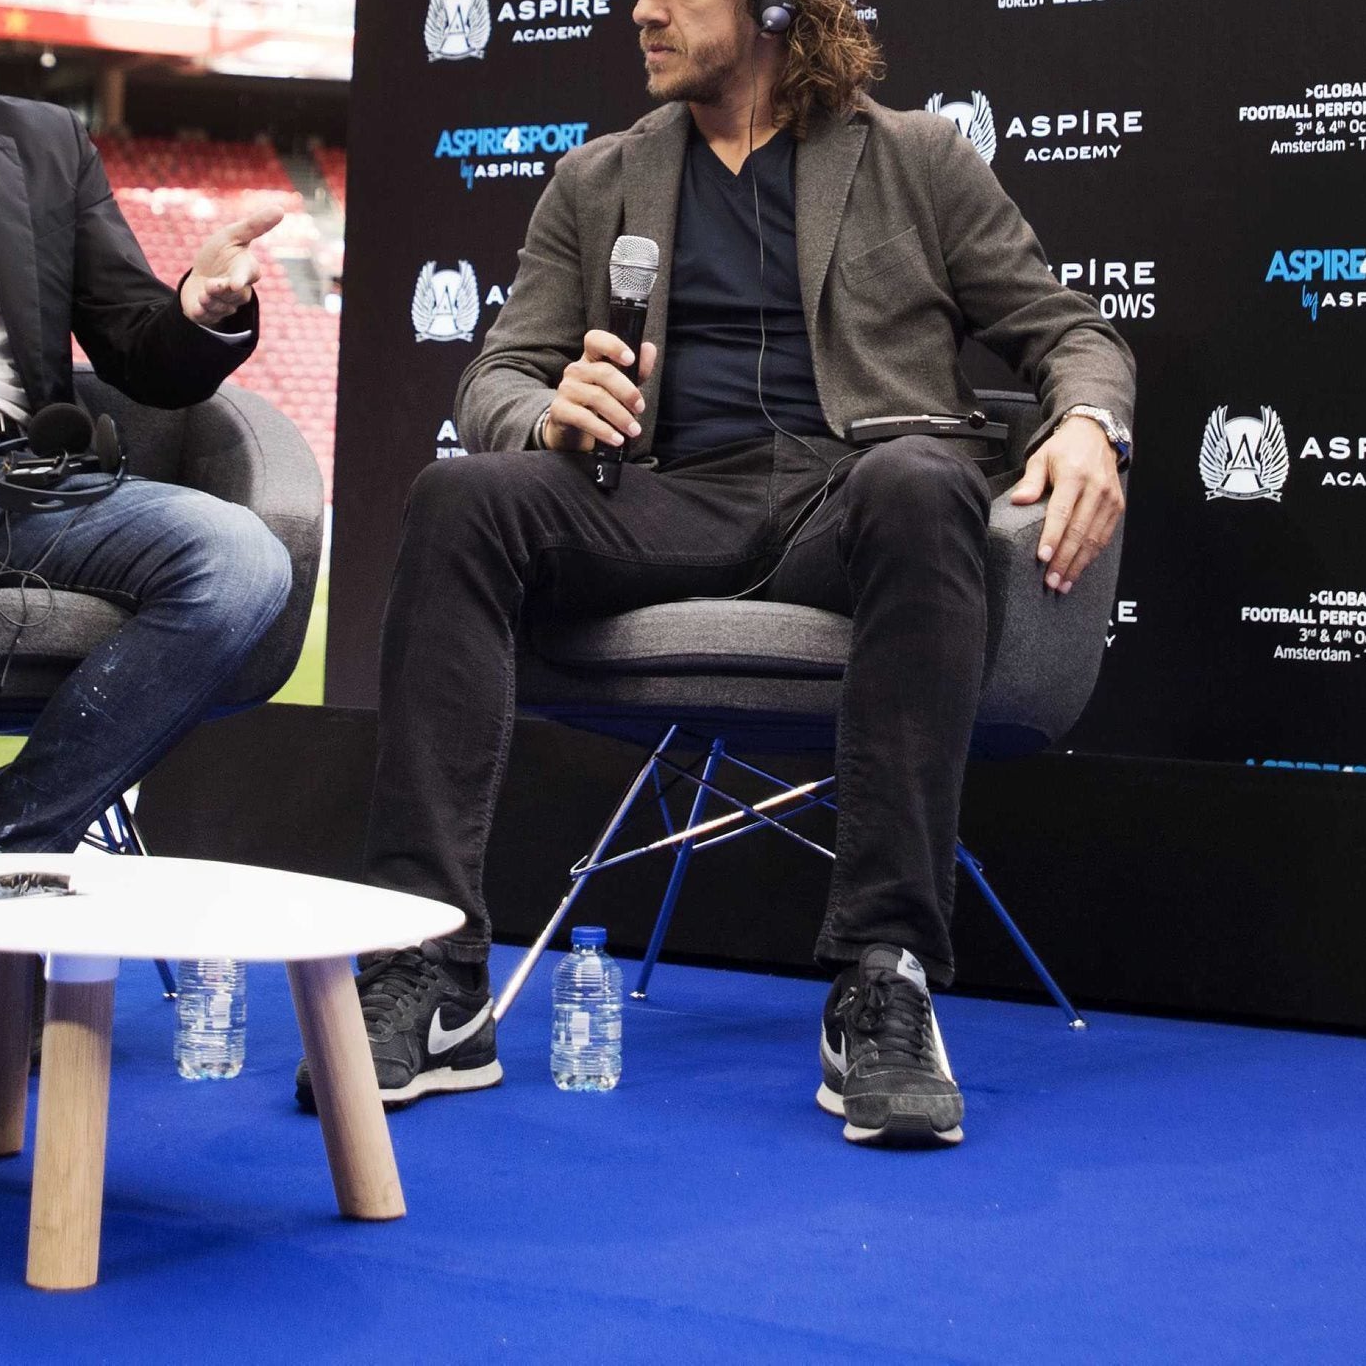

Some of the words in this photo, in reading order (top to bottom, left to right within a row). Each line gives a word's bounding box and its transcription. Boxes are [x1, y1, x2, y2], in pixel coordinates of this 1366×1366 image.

[512, 24, 593, 43] ACADEMY
[1239, 103, 1313, 122] FOOTBALL
[1005, 109, 1143, 139] ASPIRE
[1295, 120, 1313, 136] 3rd
[1315, 120, 1326, 136] &
[1328, 119, 1347, 134] 4th
[1024, 144, 1122, 162] ACADEMY
[1270, 137, 1346, 155] Amsterdam
